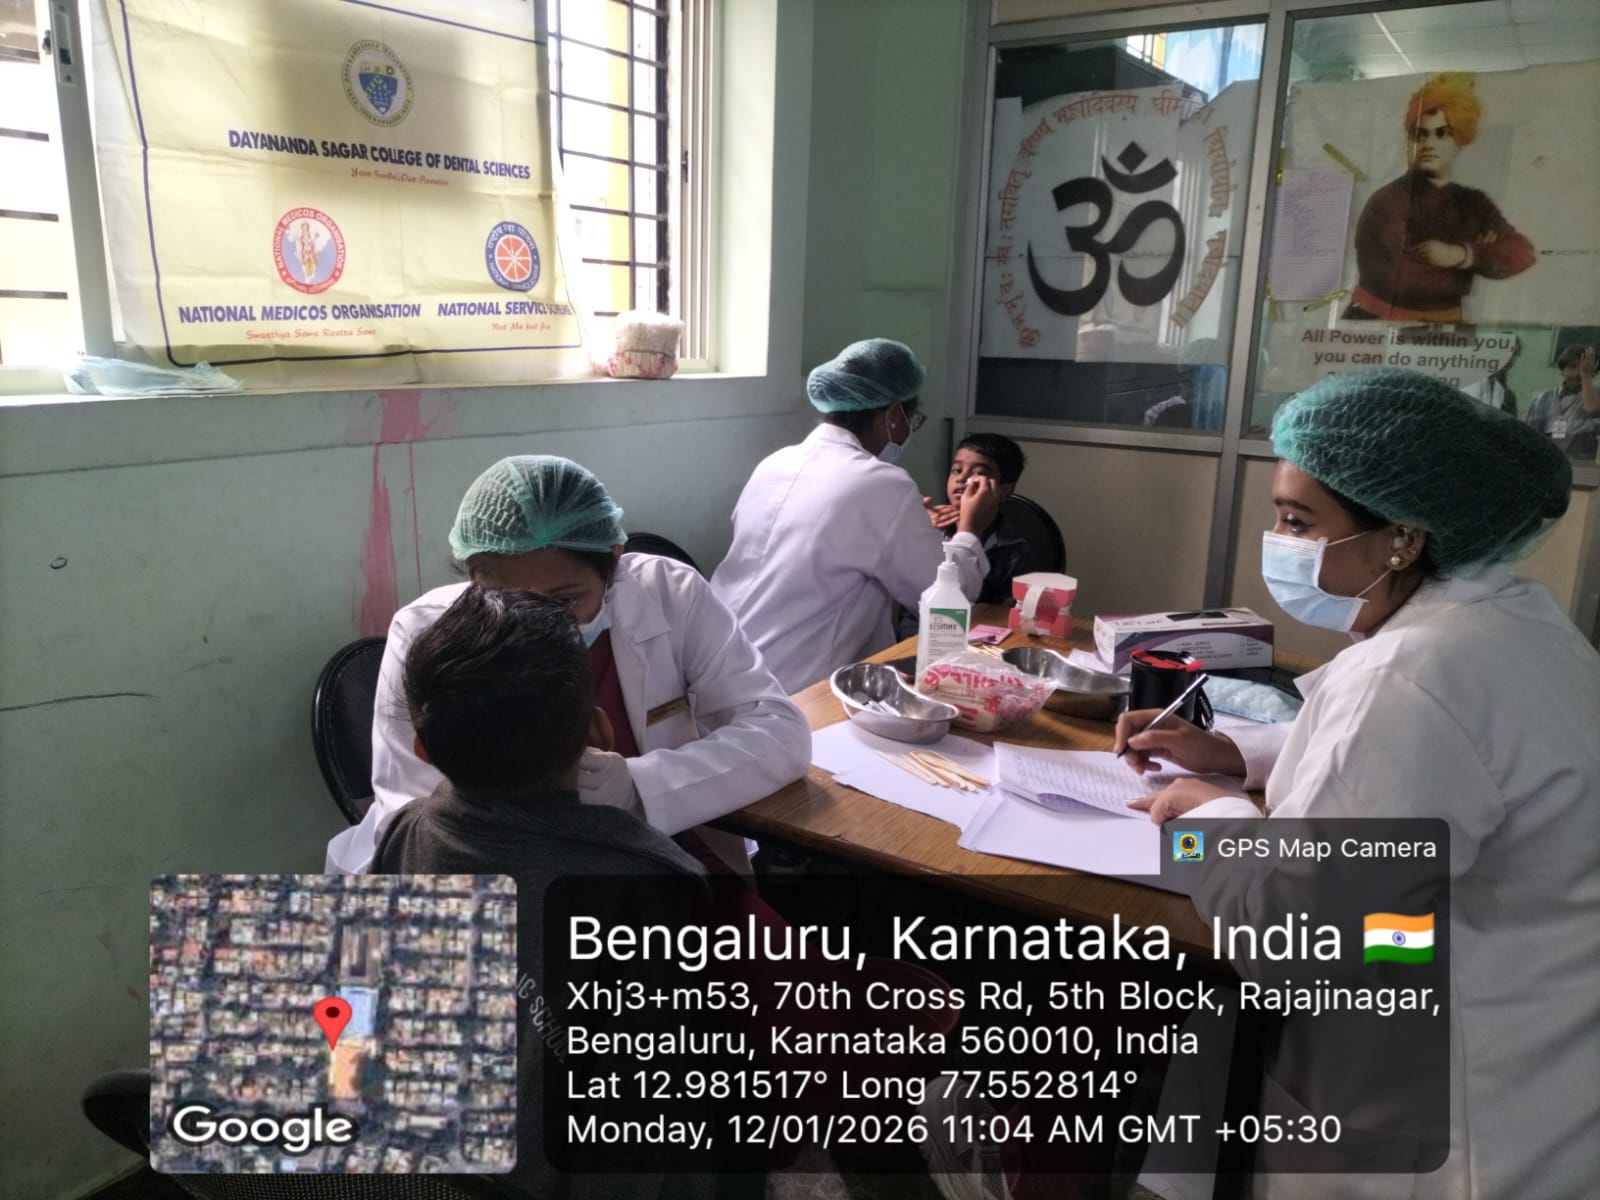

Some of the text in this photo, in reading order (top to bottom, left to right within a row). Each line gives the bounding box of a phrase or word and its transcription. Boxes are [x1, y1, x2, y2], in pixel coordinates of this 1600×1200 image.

[228, 130, 531, 179] DAYANANDA SAGAR COLLEGE OF DENTAL SCIENCES
[178, 305, 256, 323] NATIONAL
[261, 305, 328, 321] MEDICOS
[438, 302, 501, 316] NATIONAL
[505, 302, 546, 315] SERVICE
[1301, 329, 1515, 352] All Power is within you,
[1313, 351, 1499, 373] you can do anything
